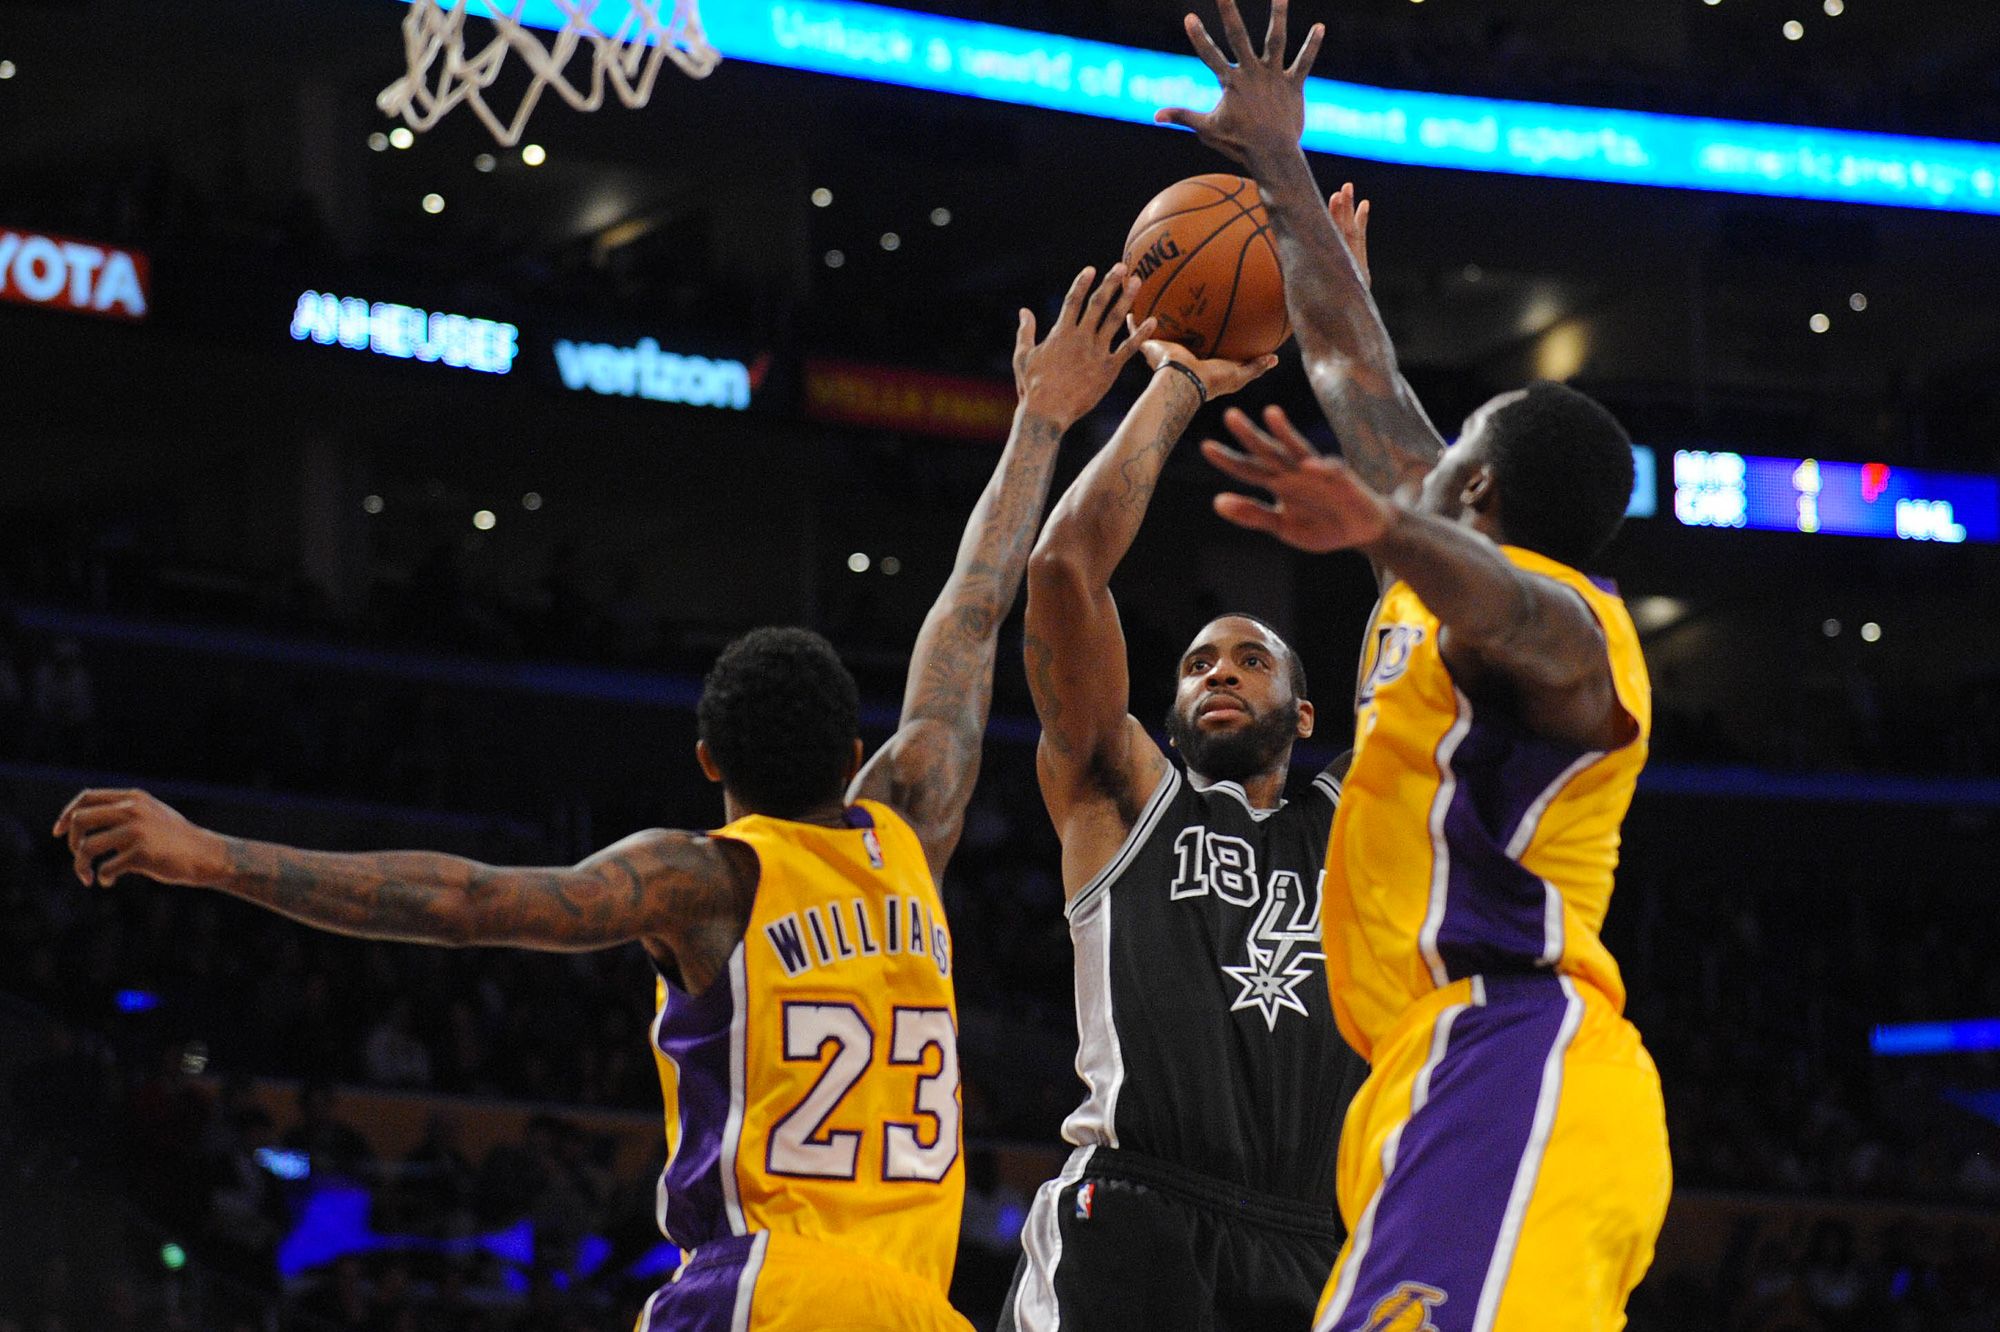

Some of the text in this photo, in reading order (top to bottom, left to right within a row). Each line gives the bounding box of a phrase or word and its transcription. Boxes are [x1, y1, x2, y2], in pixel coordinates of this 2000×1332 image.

[1132, 231, 1180, 281] ING
[553, 336, 751, 411] verizon
[1170, 825, 1260, 908] 18
[764, 894, 951, 979] WILLIAS
[765, 1001, 960, 1183] 23
